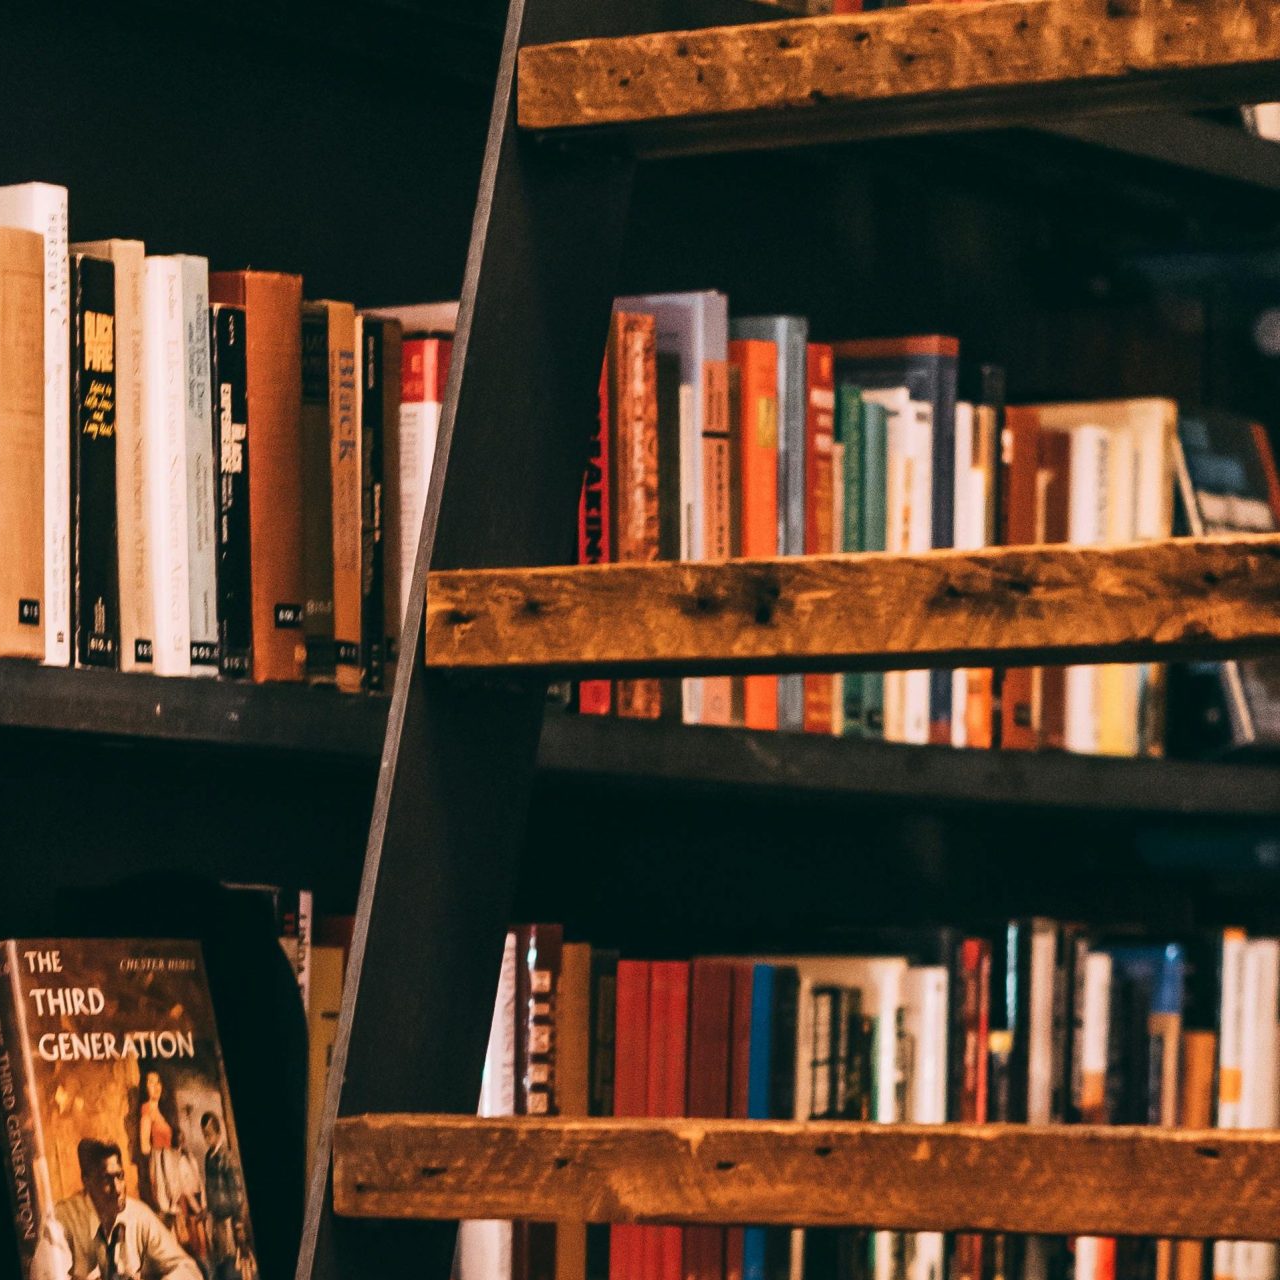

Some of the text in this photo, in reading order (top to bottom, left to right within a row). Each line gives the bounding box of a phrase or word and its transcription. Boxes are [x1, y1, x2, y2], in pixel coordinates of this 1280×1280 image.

[338, 349, 357, 465] Black
[23, 950, 64, 974] THE
[119, 957, 164, 973] CHESTER
[28, 986, 106, 1017] THIRD
[37, 1030, 196, 1062] GENERATION
[4, 1112, 36, 1240] GENERATION
